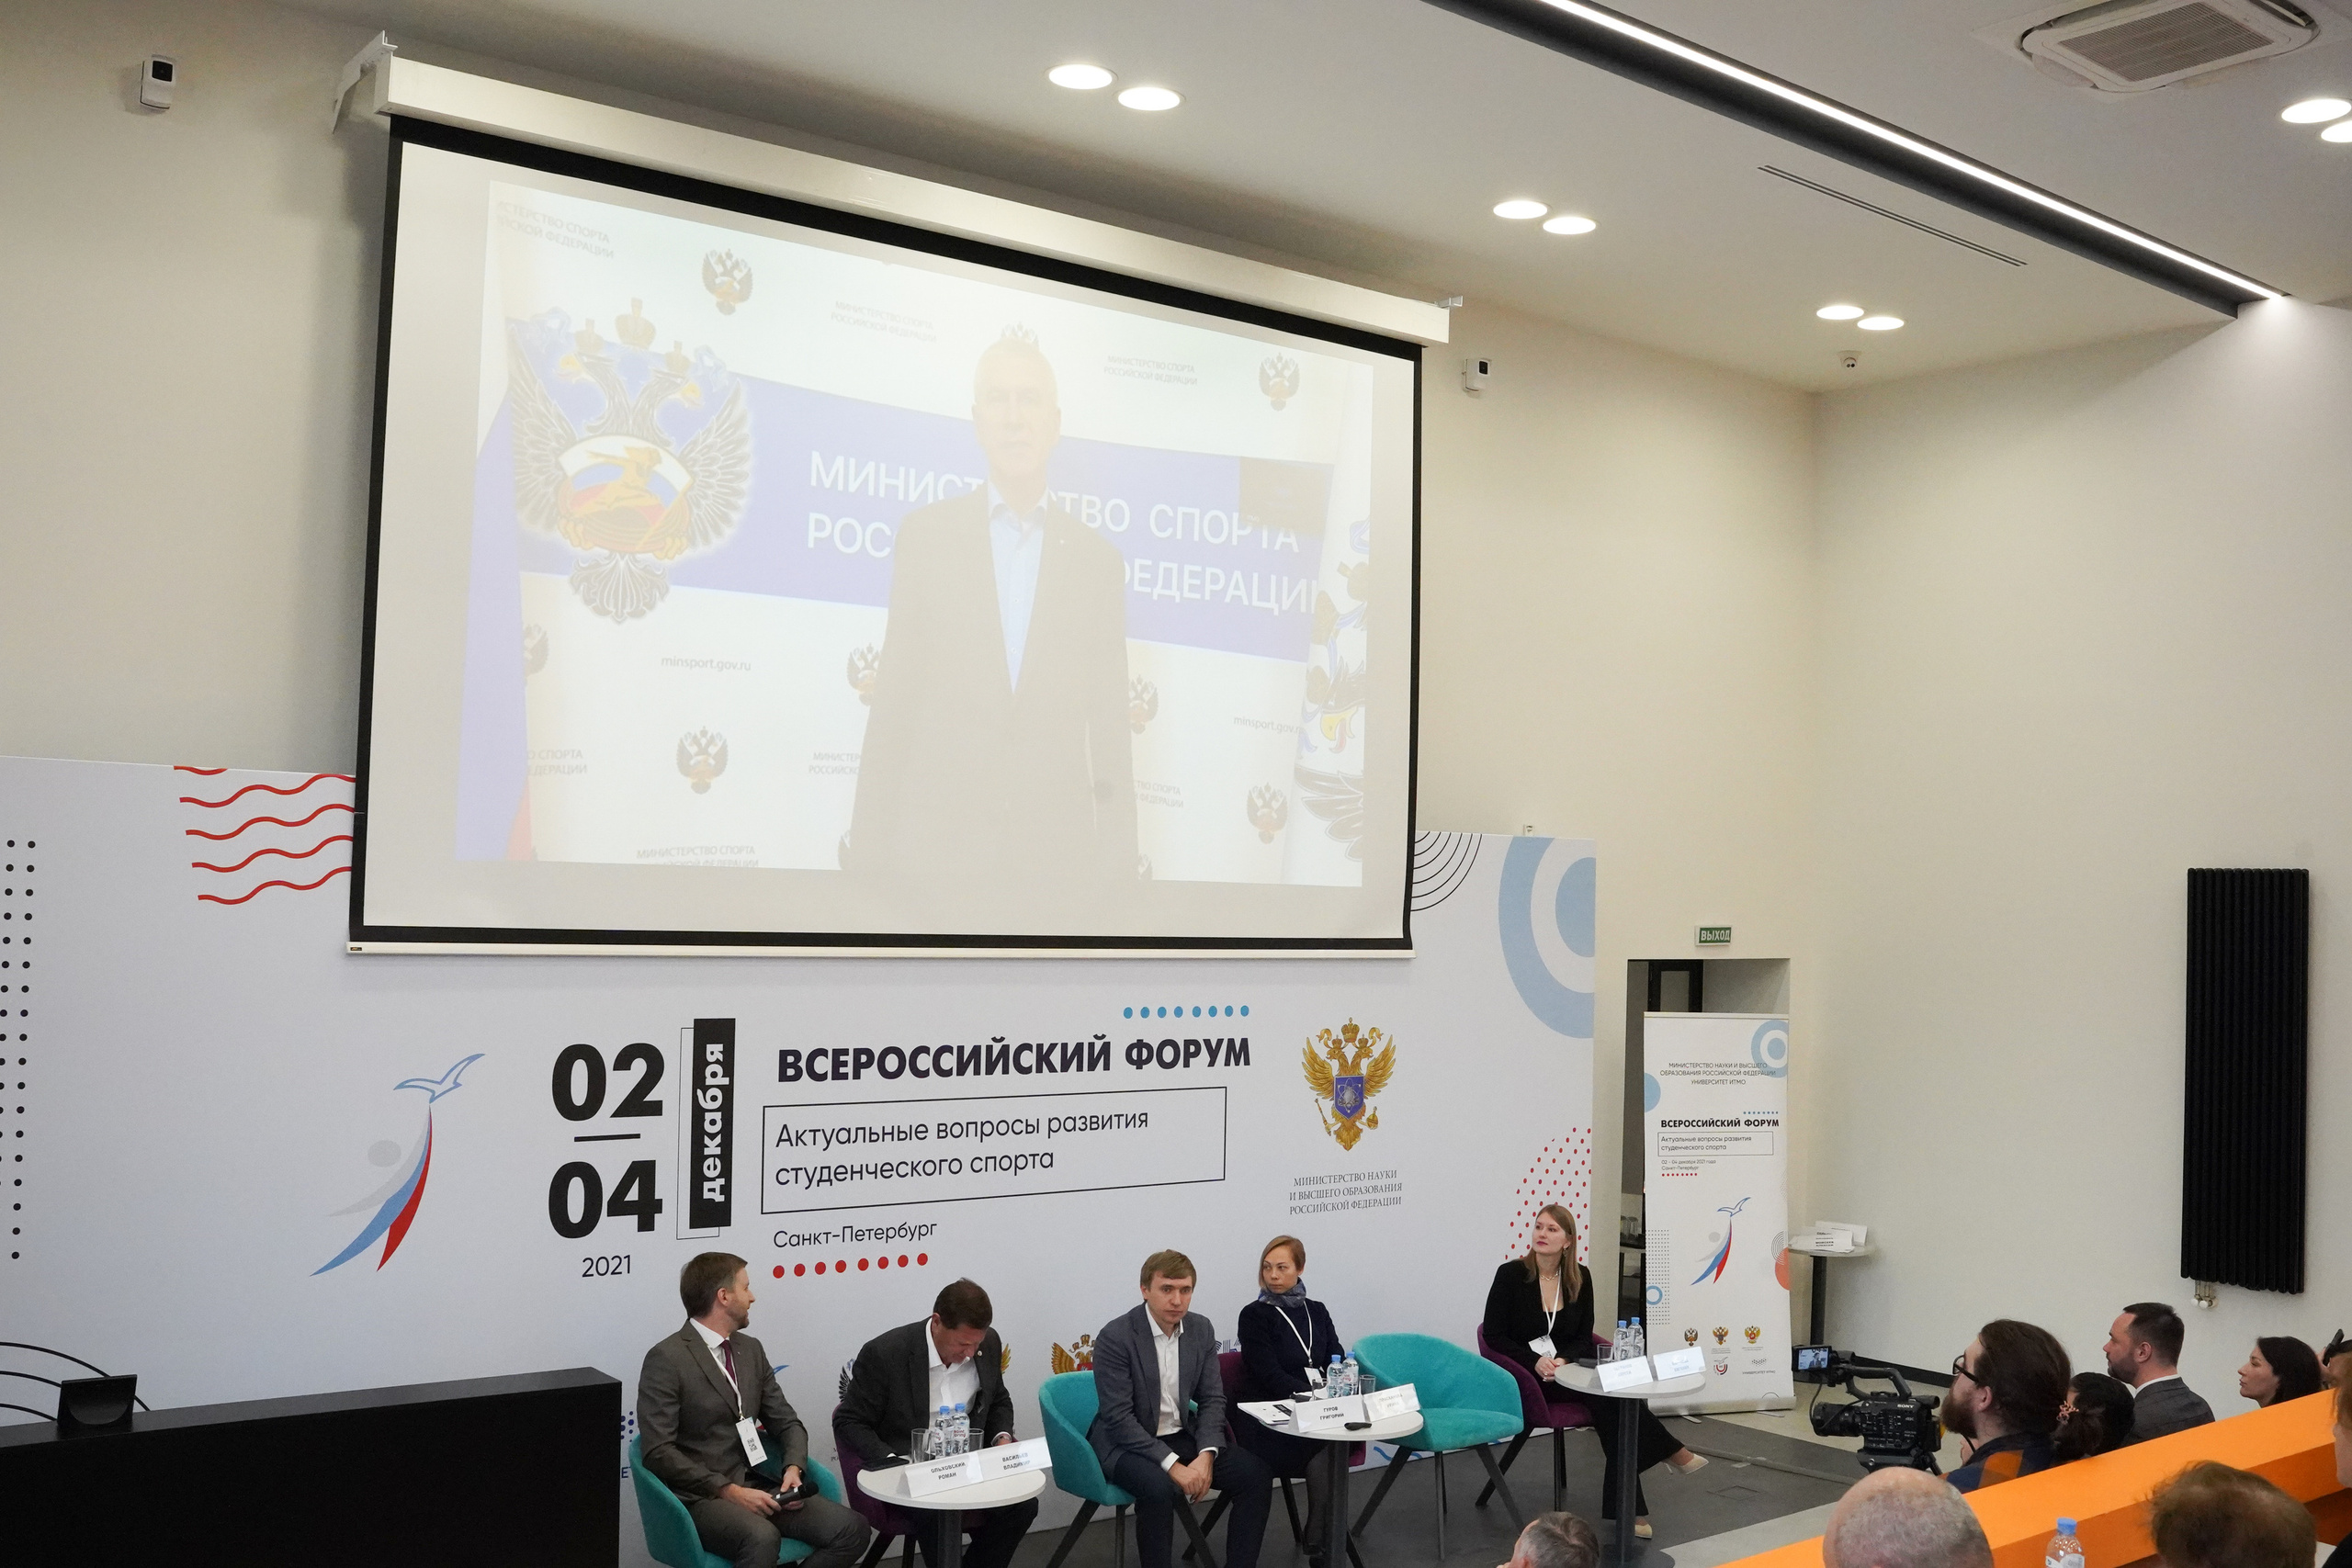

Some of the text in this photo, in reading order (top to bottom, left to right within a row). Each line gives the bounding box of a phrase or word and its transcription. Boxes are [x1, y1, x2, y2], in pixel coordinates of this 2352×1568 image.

[566, 222, 610, 243] СПОРТА
[545, 231, 614, 259] ФЕДЕРАЦИИ
[1108, 355, 1195, 374] МИНИСТЕРСТВО СПОРТА
[1103, 366, 1198, 386] РОССИЙСКОЙ ФЕДЕРАЦИИ
[1124, 558, 1317, 616] ЕДЕРАЦИ
[661, 655, 752, 672] minsport.gov.ru
[1233, 716, 1302, 735] minsport.gov.r
[537, 749, 584, 761] СПОРТА
[527, 763, 588, 777] ЕДЕРАЦИИ
[1152, 783, 1182, 796] СПОРТА
[636, 845, 756, 859] МИНИСТЕРСТВО СПОРТА
[1701, 928, 1731, 942] ВЫХОД
[777, 1033, 1251, 1082] ВСЕРОССИЙСКИЙ ФОРУМ
[551, 1043, 665, 1122] 02
[696, 1043, 730, 1203] декабря
[775, 1111, 1149, 1151] Актуальные вопросы развития
[1660, 1118, 1780, 1128] ВСЕРОССИЙСКИЙ ФОРУМ
[775, 1150, 1055, 1188] студенческого спорта
[1294, 1169, 1397, 1187] МИНИСТЕРСТВО НАУКИ
[548, 1159, 663, 1239] 04
[1289, 1182, 1403, 1201] И ВЫСШЕГО ОБРАЗОВАНИЯ
[1289, 1196, 1402, 1215] РОССИЙСКОЙ ФЕДЕРАЦИИ
[773, 1221, 938, 1248] Санкт-Петербург
[582, 1254, 631, 1278] 2021
[931, 1461, 967, 1473] ОЛЬХОВСКИЙ
[938, 1472, 957, 1480] РОМАН
